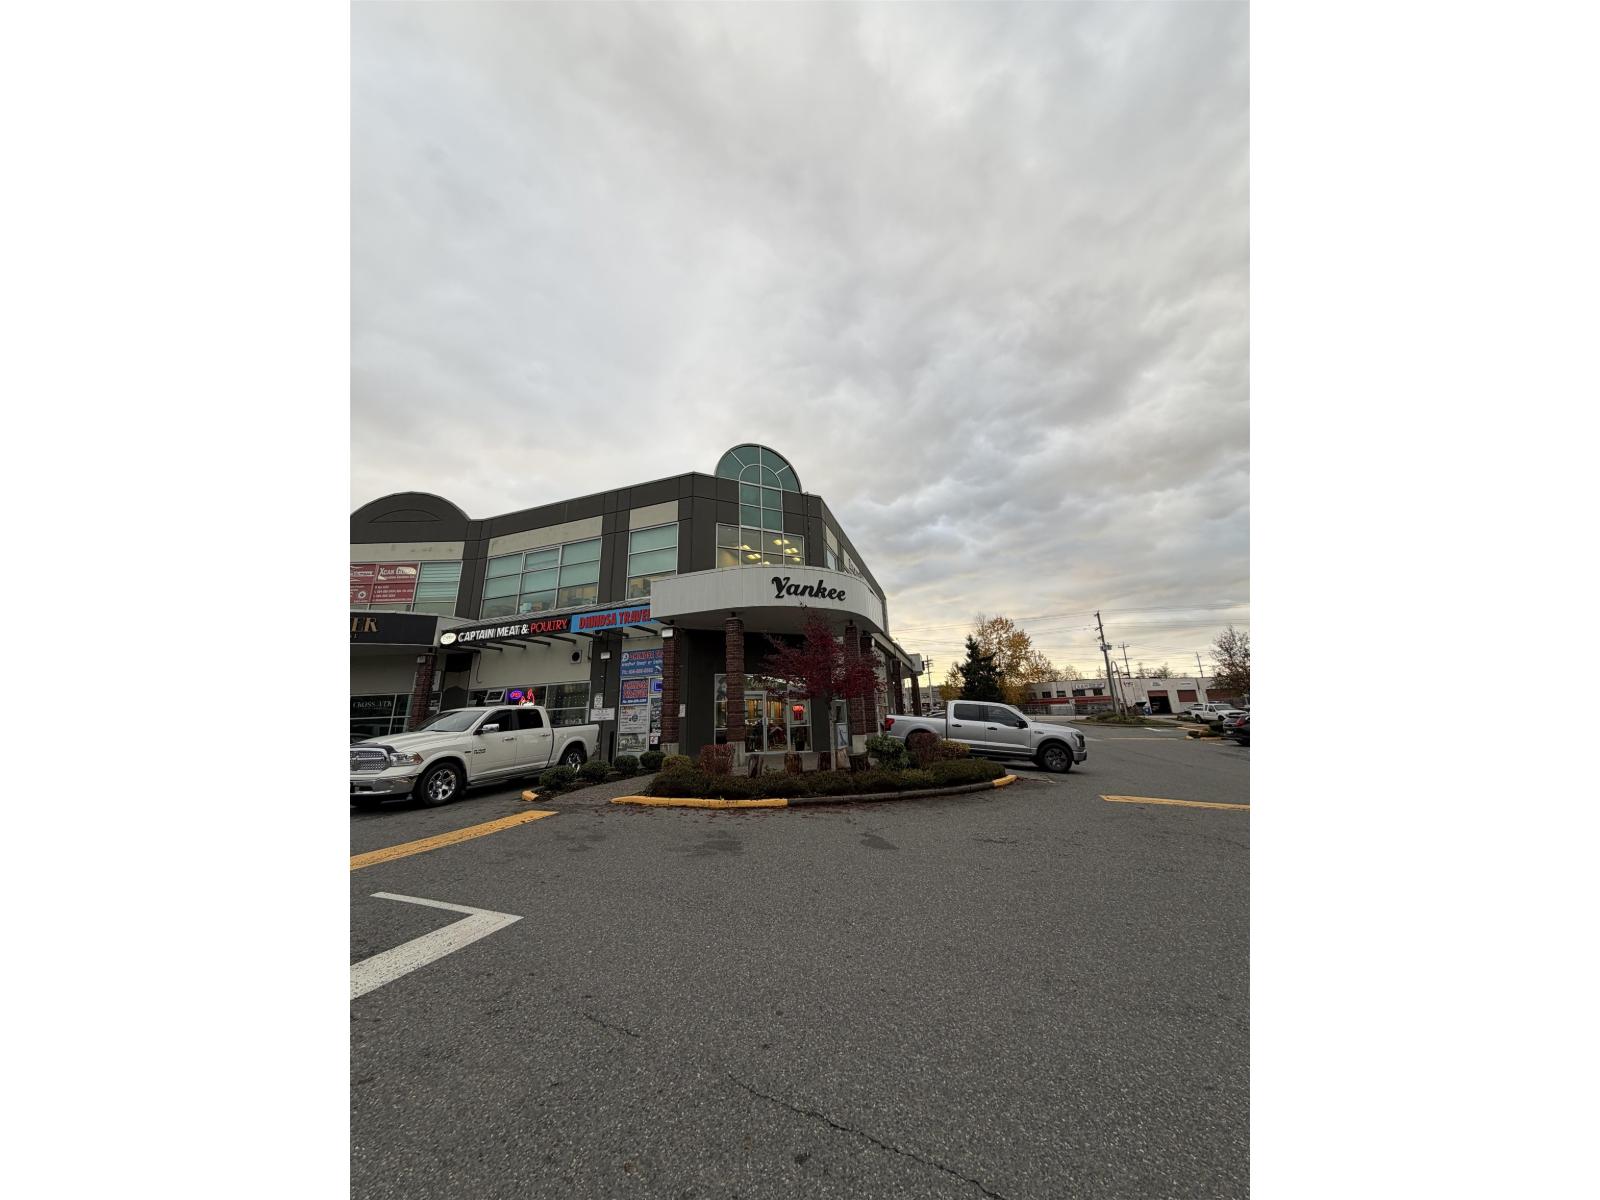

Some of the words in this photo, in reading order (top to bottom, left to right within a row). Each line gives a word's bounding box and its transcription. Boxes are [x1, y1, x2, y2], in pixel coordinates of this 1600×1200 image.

[771, 576, 847, 602] Yankee
[458, 629, 496, 643] CAPTAIN
[496, 624, 520, 638] MEAT
[520, 623, 529, 635] &
[530, 618, 568, 634] POULTRY
